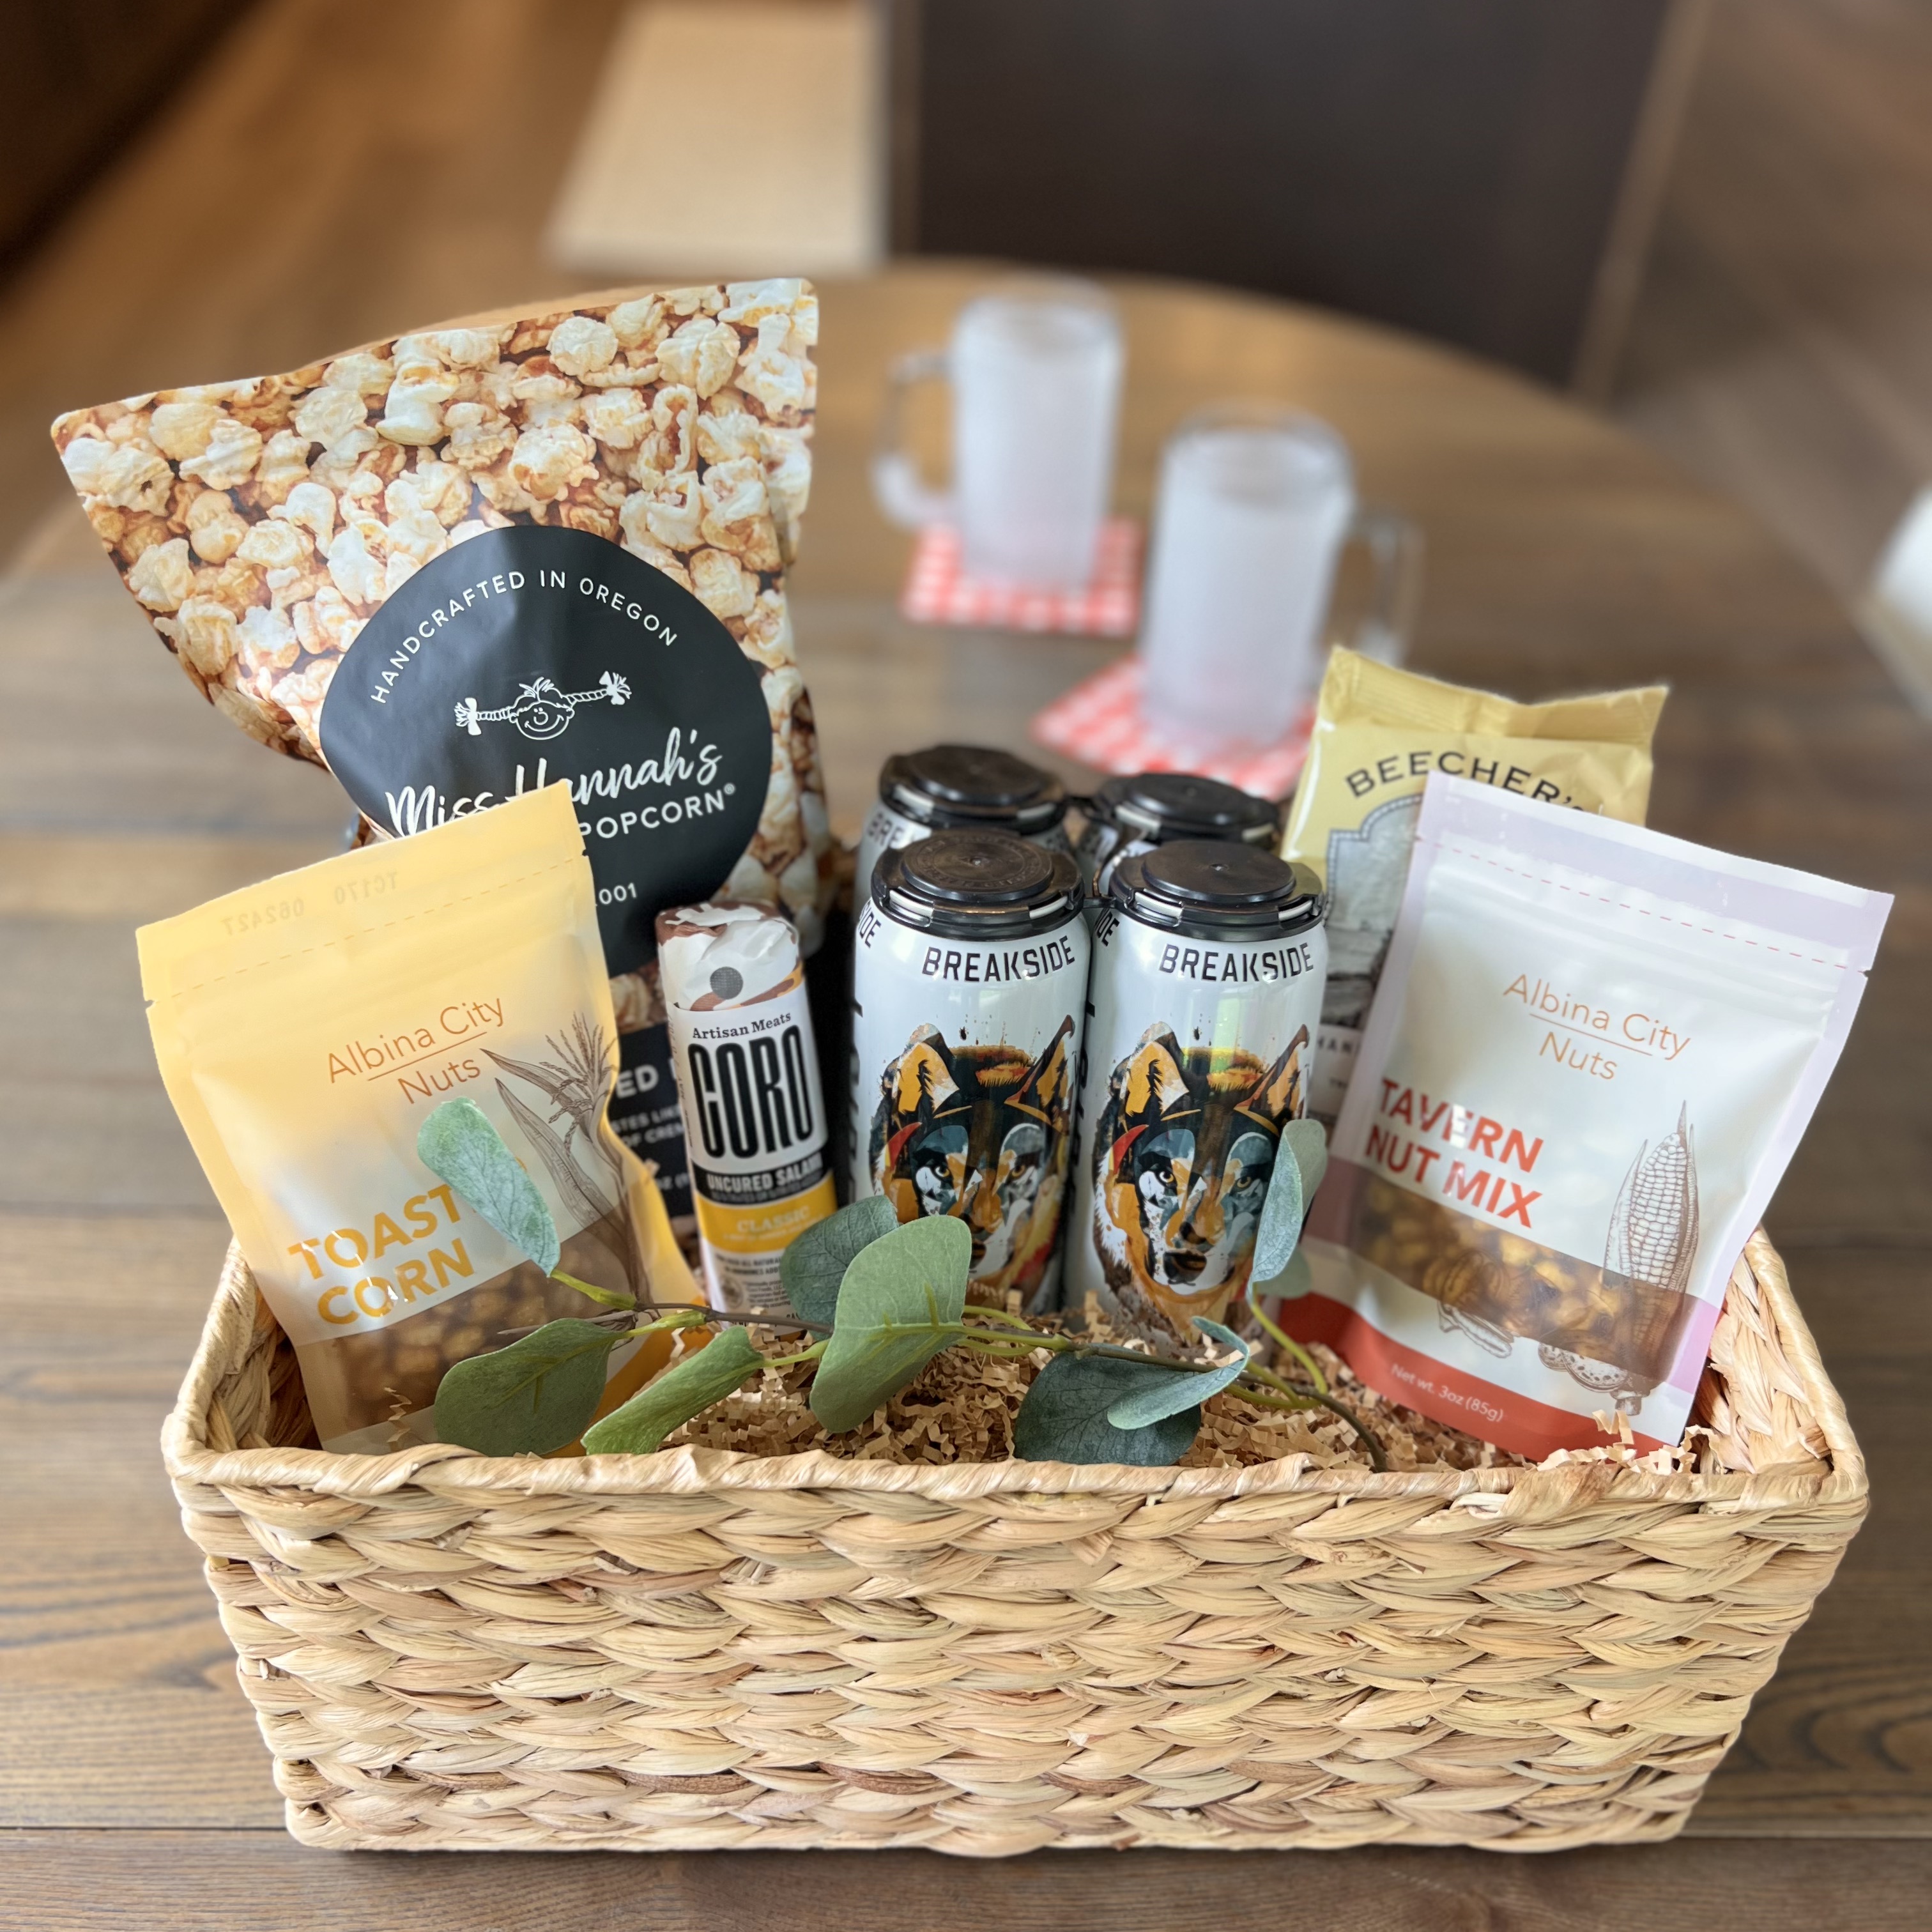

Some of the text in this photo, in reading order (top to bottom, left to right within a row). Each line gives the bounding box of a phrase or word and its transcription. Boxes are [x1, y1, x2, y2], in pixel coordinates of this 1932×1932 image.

[370, 570, 677, 703] HANDCRAFTED IN OREGON
[505, 726, 723, 805] Hnnah's
[1345, 751, 1584, 812] BEECHER'
[595, 882, 637, 907] 001
[922, 935, 1075, 982] BREAKSIDE
[1159, 942, 1314, 982] BREAKSIDE
[328, 998, 503, 1084] Albina City
[693, 1013, 792, 1039] Artisan Meats
[1503, 974, 1691, 1061] Albina City
[397, 1059, 480, 1104] Nuts
[1539, 1031, 1617, 1080] Nuts
[687, 1025, 813, 1159] CORO
[1381, 1077, 1544, 1173] TAVERN
[707, 1172, 774, 1193] UNCURED
[1365, 1123, 1543, 1229] NUT MIX
[288, 1183, 474, 1280] TOAST
[737, 1205, 810, 1233] CLASSIC
[318, 1237, 475, 1325] CORN
[1391, 1363, 1505, 1422] Net wt. 3oz (85g)
